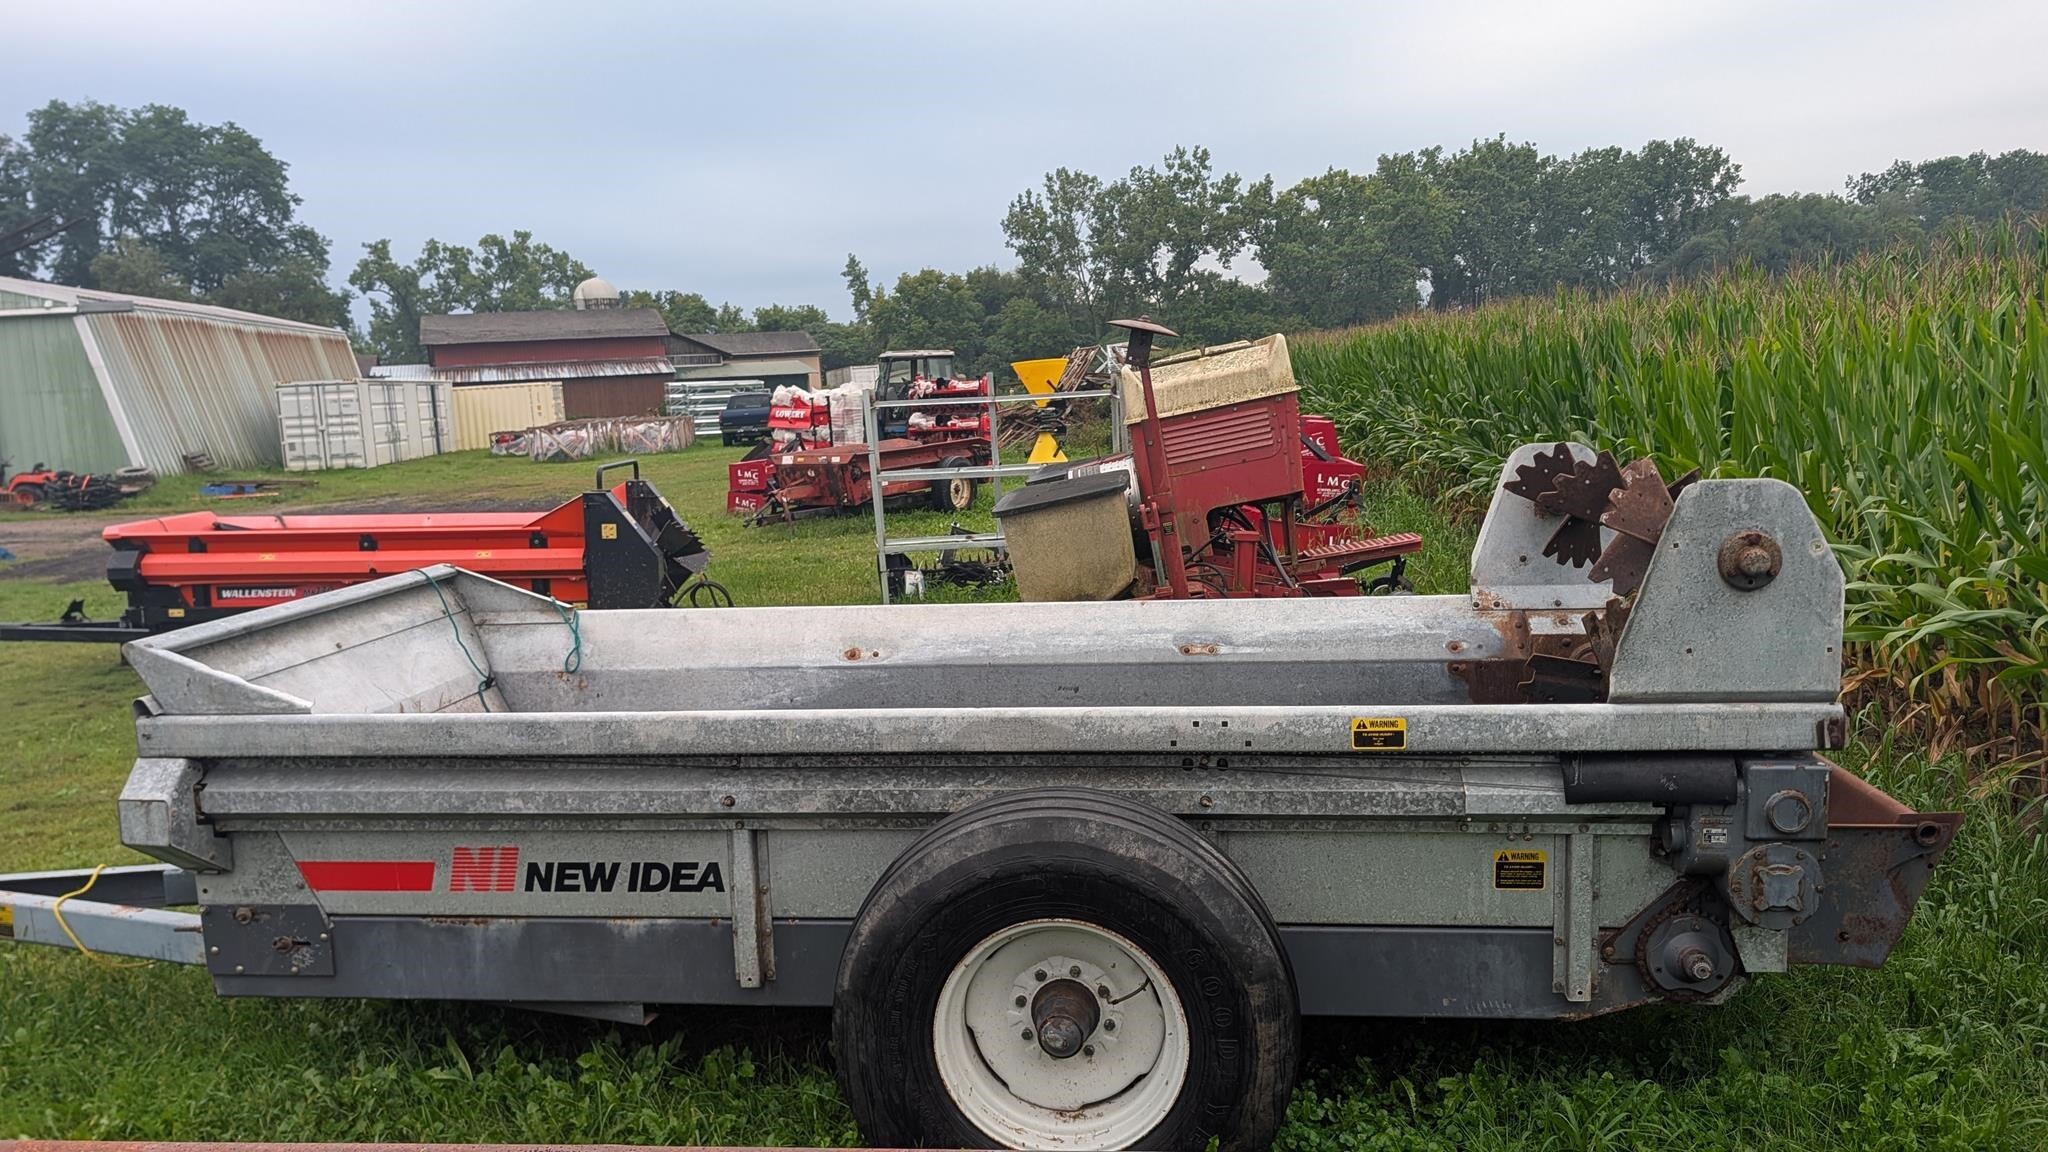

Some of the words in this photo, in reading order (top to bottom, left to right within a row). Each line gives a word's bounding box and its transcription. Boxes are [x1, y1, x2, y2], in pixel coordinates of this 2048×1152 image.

[221, 588, 297, 598] WALLENSTEIN
[1368, 720, 1399, 729] WARNING
[1510, 852, 1540, 861] WARNING
[450, 847, 519, 892] NI
[525, 862, 621, 892] NEW
[627, 862, 726, 892] IDEA
